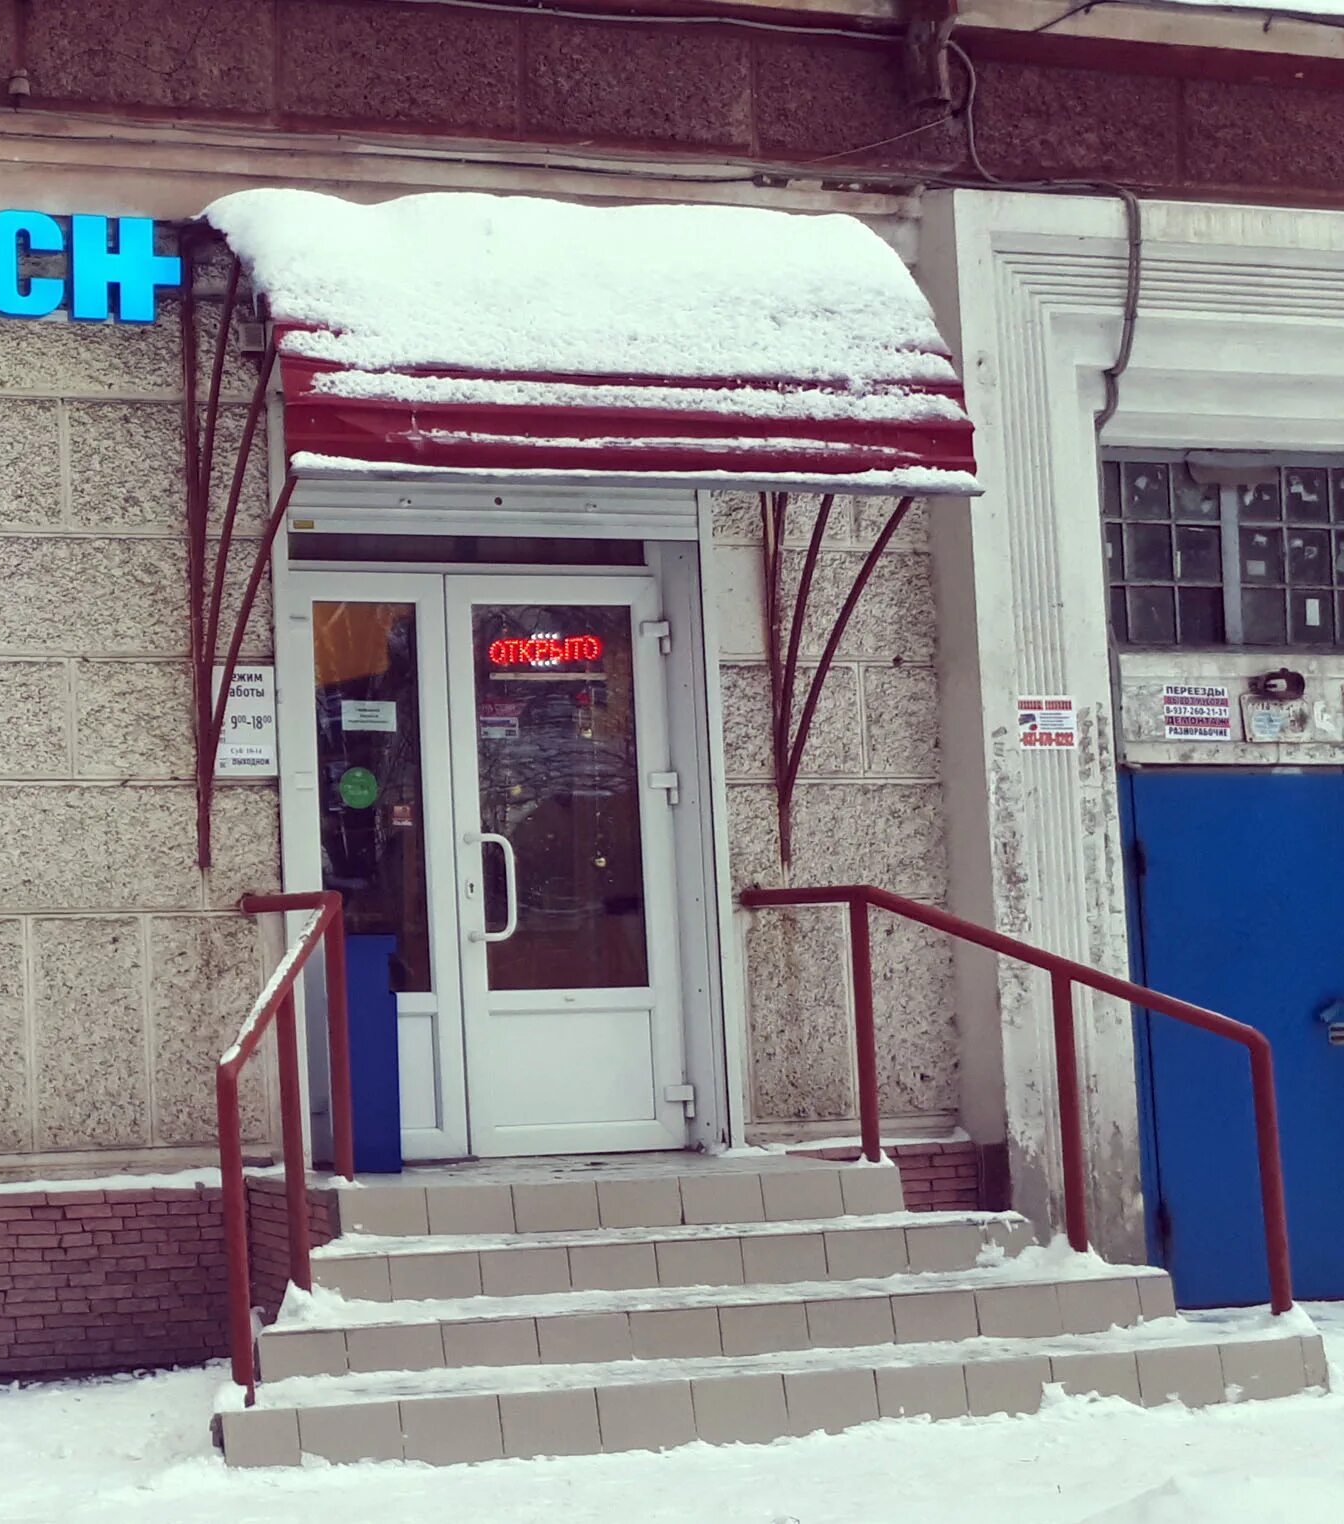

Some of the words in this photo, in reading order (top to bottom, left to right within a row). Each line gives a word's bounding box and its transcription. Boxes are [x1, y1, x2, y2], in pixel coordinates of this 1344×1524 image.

[488, 637, 601, 664] ОТКРЫТО
[229, 673, 263, 682] ежим
[228, 685, 265, 697] аботы
[1166, 686, 1225, 696] ПЕРЕЕЗДЫ
[1167, 716, 1229, 727] ДЕМОНТАЖ
[1168, 727, 1227, 737] РАЗНОРАБОЧИЕ
